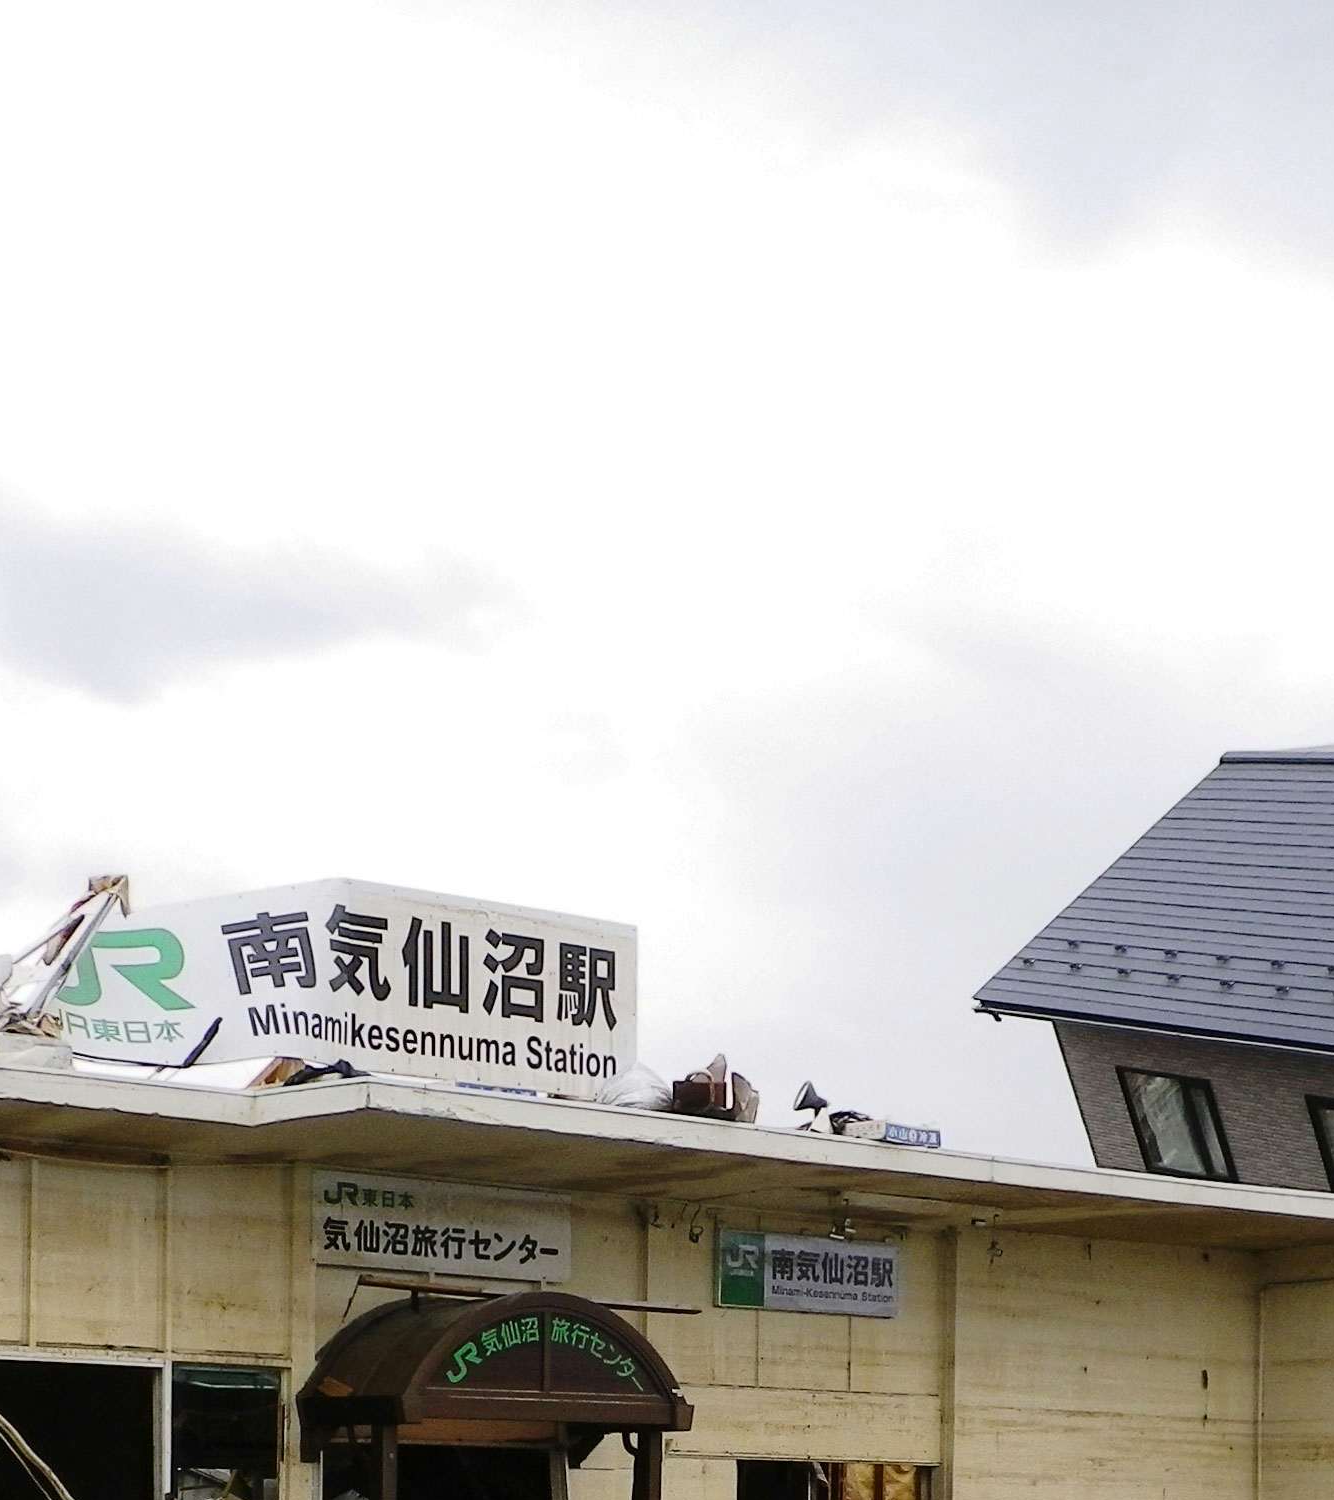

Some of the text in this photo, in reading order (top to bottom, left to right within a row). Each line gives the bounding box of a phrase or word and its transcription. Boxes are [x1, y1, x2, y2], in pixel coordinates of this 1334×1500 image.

[55, 928, 196, 1010] JR
[221, 903, 618, 1032] 南気仙沼駅
[248, 1004, 618, 1080] Minamikesennuma Station
[323, 1181, 415, 1209] JR東日本
[322, 1216, 559, 1265] 気仙沼旅行センター
[725, 1243, 760, 1270] JR
[771, 1248, 894, 1289] 南気仙沼駅
[861, 1291, 895, 1304] Station
